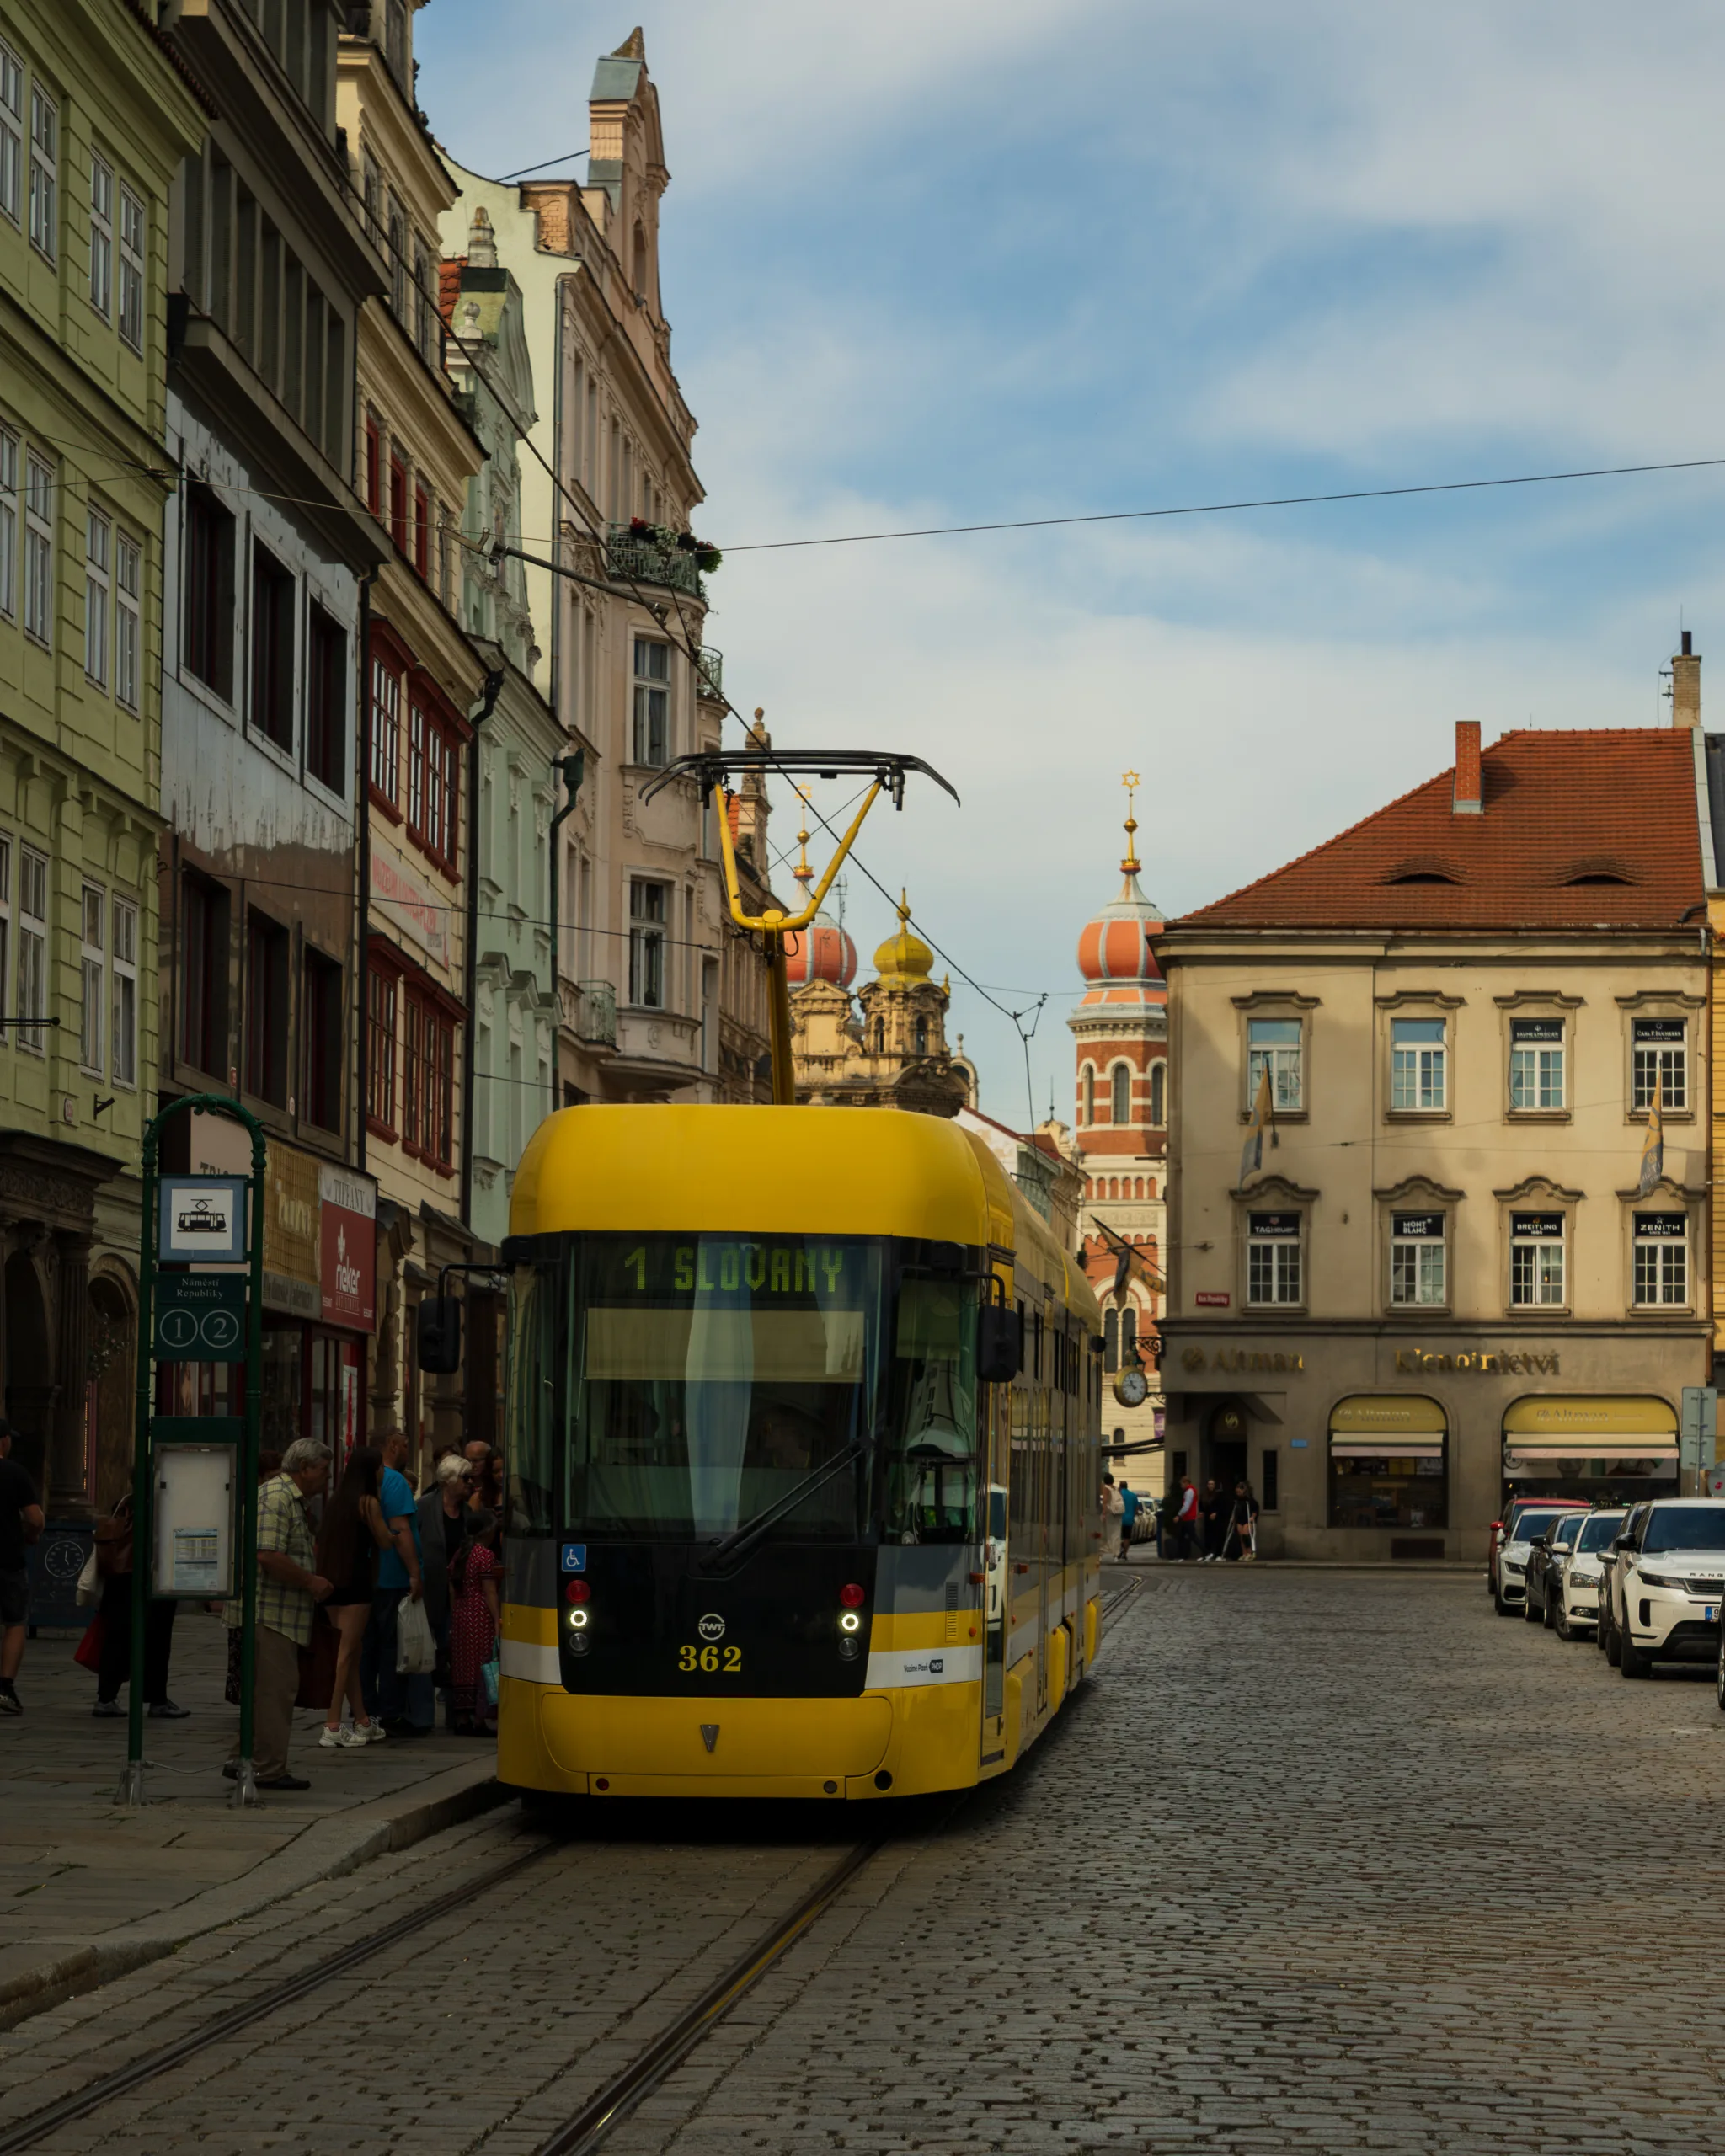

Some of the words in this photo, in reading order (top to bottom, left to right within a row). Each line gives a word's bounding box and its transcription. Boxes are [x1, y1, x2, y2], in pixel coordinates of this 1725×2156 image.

[334, 1178, 365, 1213] TIFFANY
[336, 1256, 360, 1295] rieker
[624, 1246, 646, 1290] 1
[675, 1246, 842, 1293] SLOVANY
[182, 1278, 219, 1287] Náměstí
[176, 1289, 223, 1299] Republiky
[174, 1316, 184, 1338] 1
[212, 1317, 227, 1338] 2
[1212, 1348, 1304, 1371] Altman
[1356, 1408, 1411, 1422] Altman
[1553, 1409, 1609, 1422] Altman
[698, 1622, 725, 1631] TWT
[678, 1645, 742, 1672] 362
